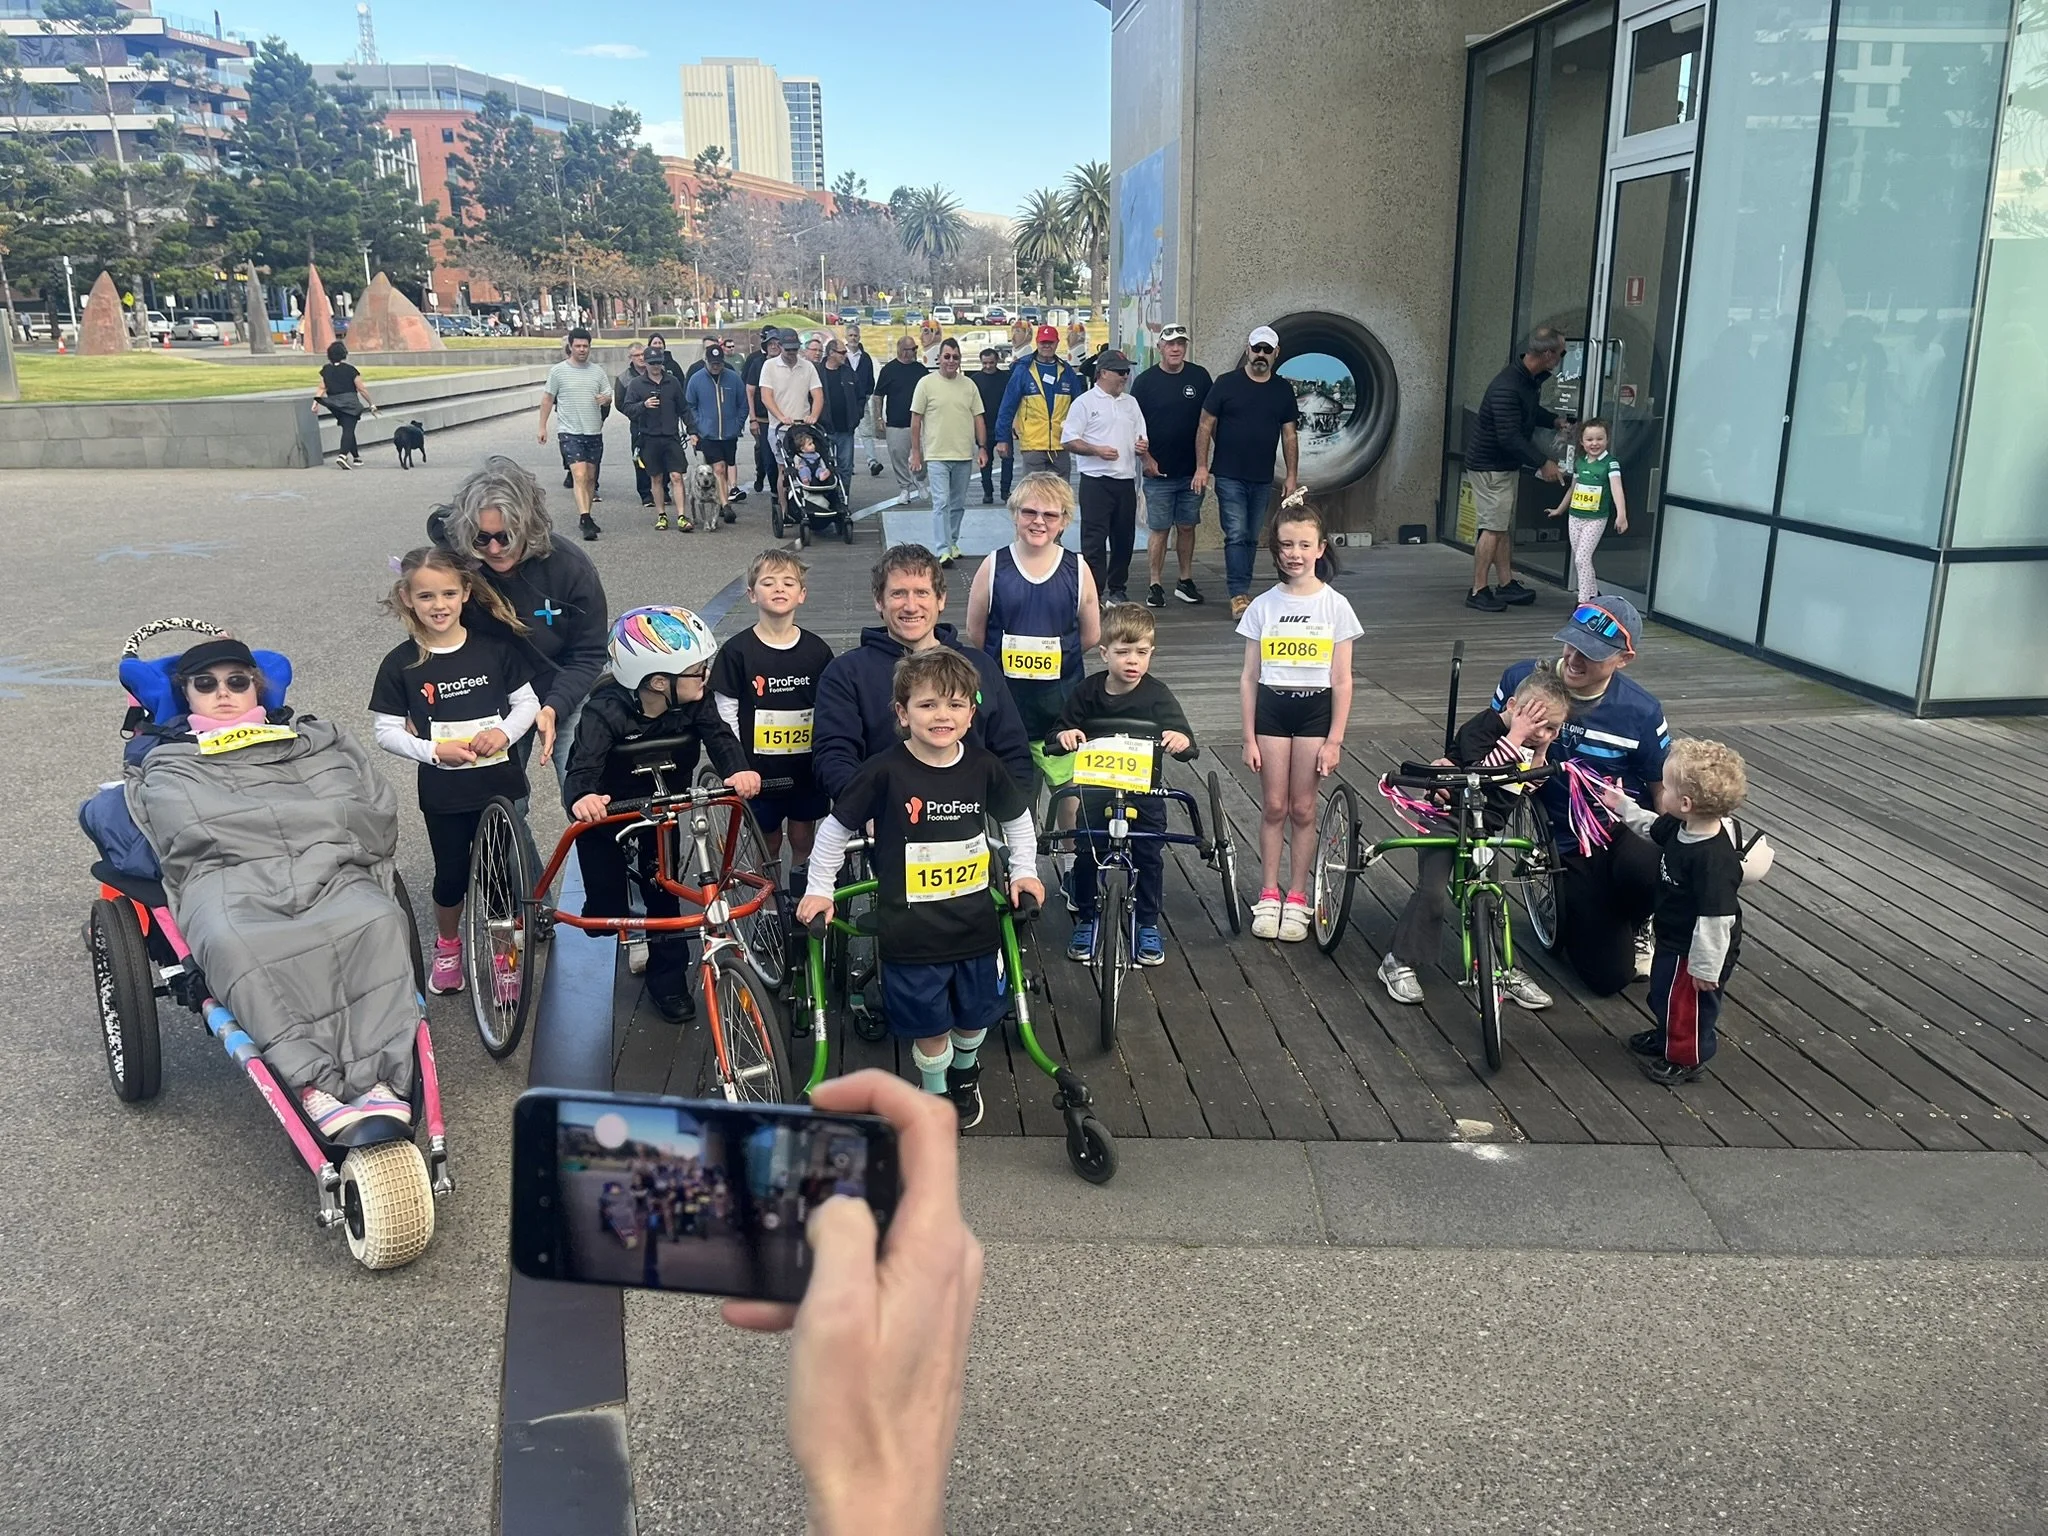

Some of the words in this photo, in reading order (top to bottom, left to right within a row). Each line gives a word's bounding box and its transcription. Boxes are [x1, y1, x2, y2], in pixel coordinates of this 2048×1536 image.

[1268, 641, 1318, 656] 12086
[1007, 654, 1052, 670] 15056
[437, 675, 489, 694] ProFeet
[768, 676, 810, 688] ProFeet
[763, 729, 810, 744] 15125
[1084, 754, 1137, 772] 12219
[926, 801, 981, 814] ProFeet
[917, 862, 978, 887] 15127
